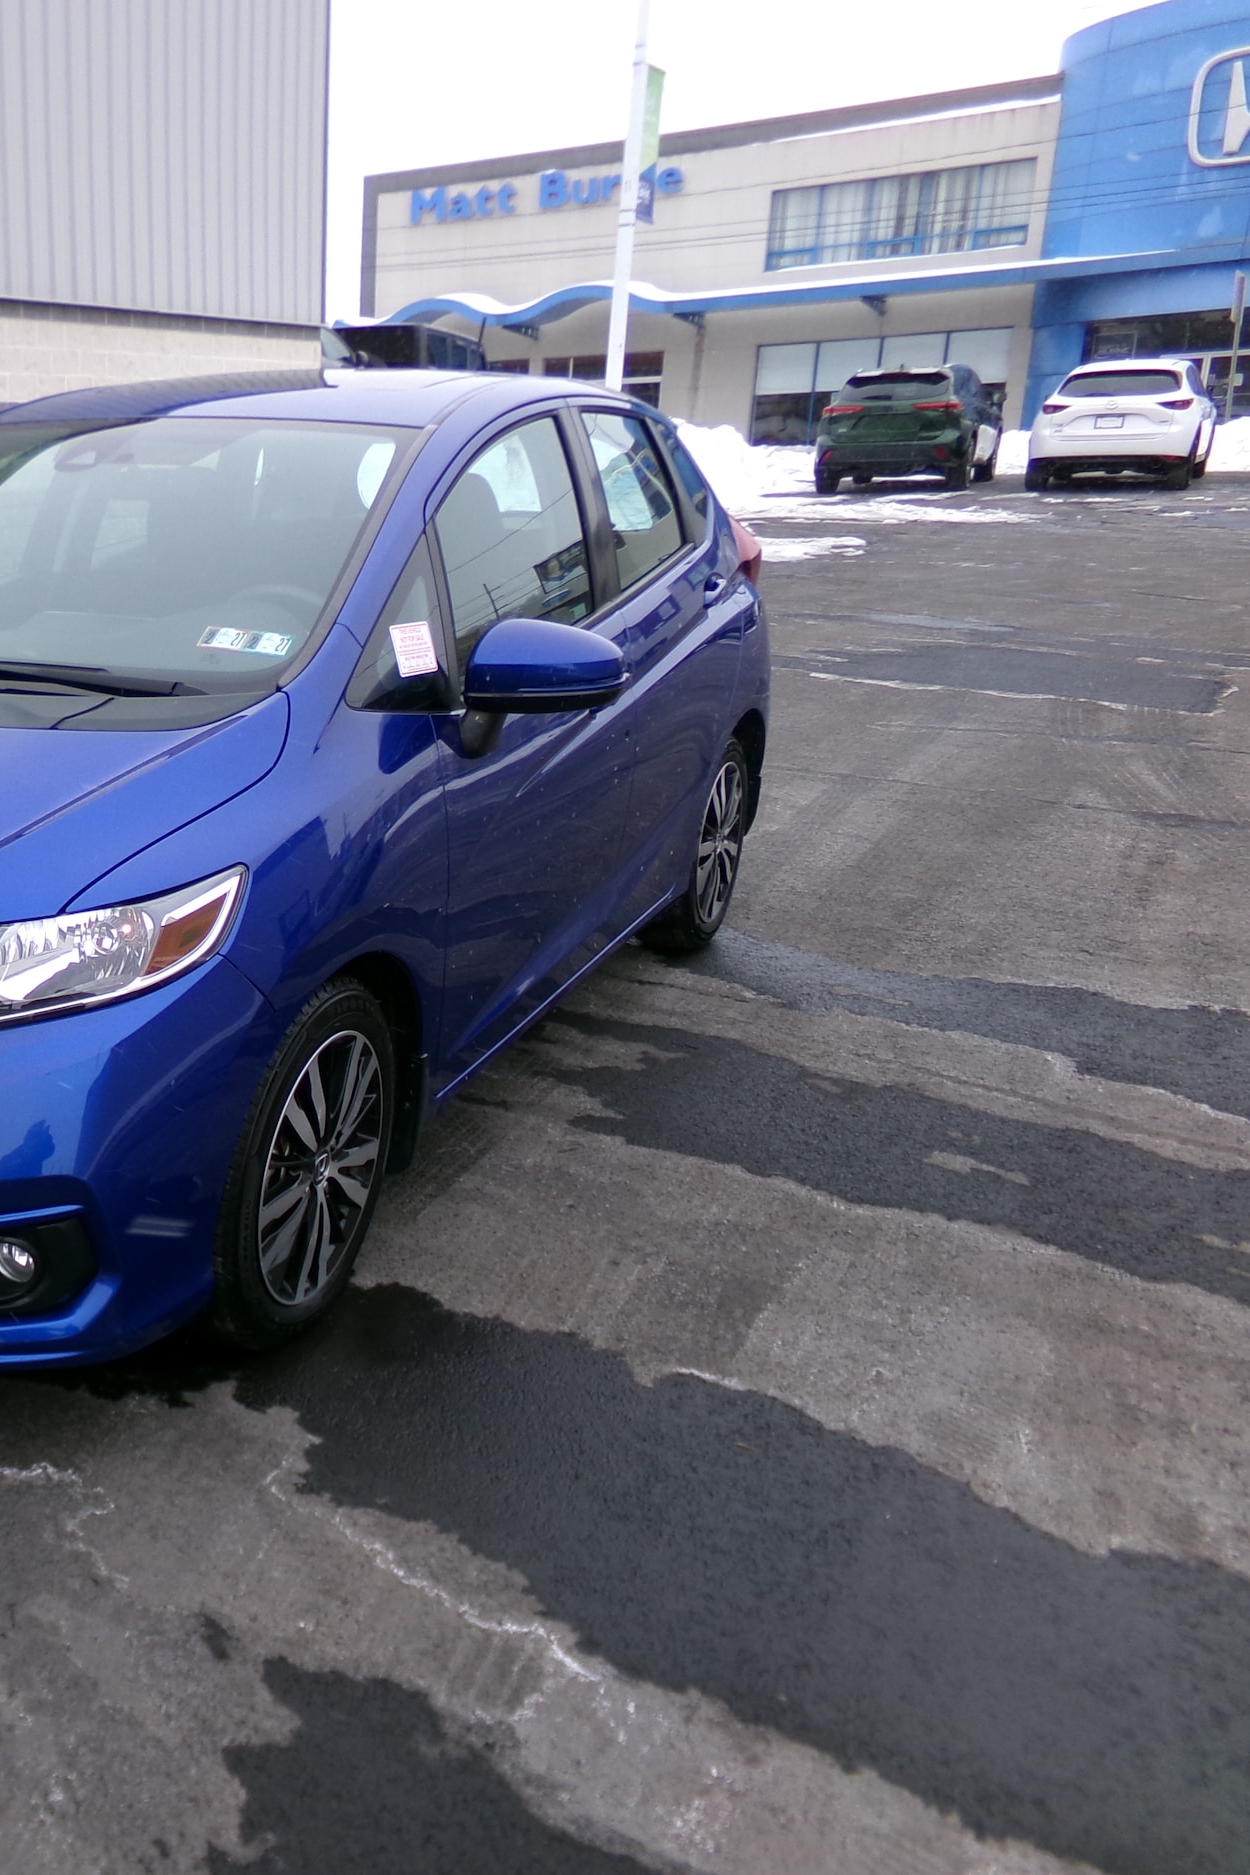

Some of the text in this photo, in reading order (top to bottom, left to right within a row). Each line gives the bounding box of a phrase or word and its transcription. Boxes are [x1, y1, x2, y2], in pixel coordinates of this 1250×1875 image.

[409, 183, 518, 224] Matt
[539, 167, 684, 209] Bure
[230, 632, 246, 647] 27
[274, 637, 291, 653] 27
